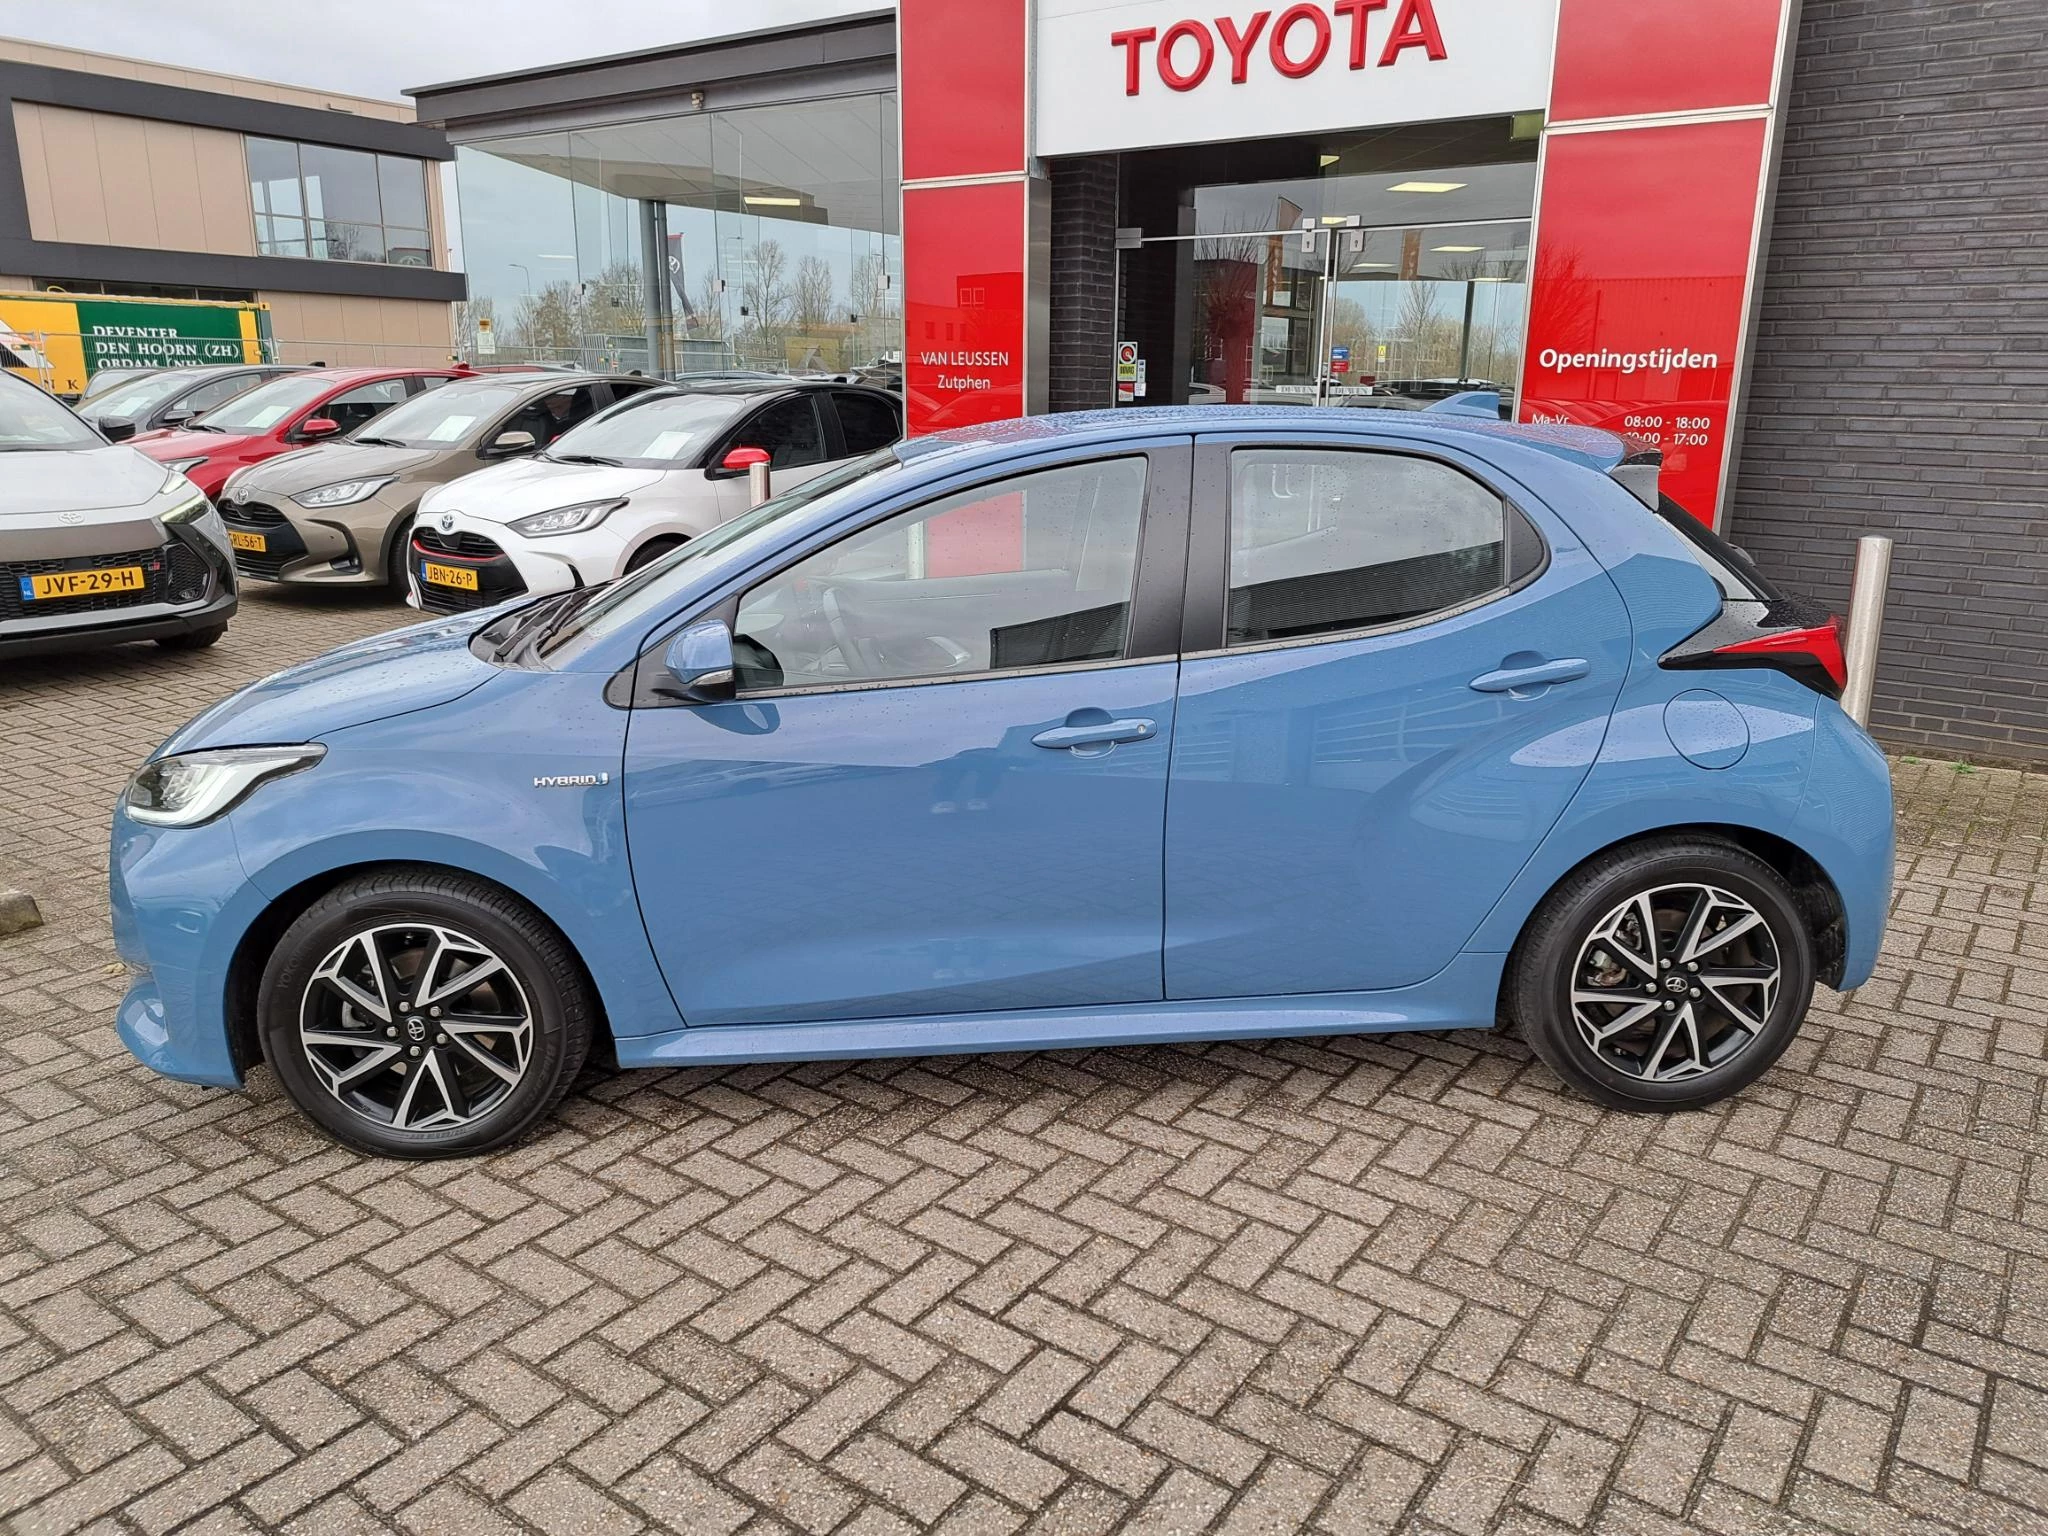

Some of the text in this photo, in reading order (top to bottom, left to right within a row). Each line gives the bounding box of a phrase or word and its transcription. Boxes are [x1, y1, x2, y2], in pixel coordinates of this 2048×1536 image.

[1111, 0, 1447, 96] TOYOTA
[92, 325, 178, 338] DEVENTER
[95, 342, 239, 358] DEN HOORN (ZH)
[921, 352, 1009, 366] VAN LEUSSEN
[1539, 348, 1718, 374] Openingstijden
[937, 374, 991, 392] Zutphen
[1532, 413, 1570, 424] Ma-Vr
[1624, 416, 1663, 428] 08:00
[1675, 417, 1711, 429] 18:00
[1673, 433, 1708, 446] 17:00
[229, 533, 263, 550] RL-56-T
[42, 570, 135, 595] JVF-29-H
[429, 566, 473, 587] JBN-26-P
[533, 775, 597, 787] HYBRID
